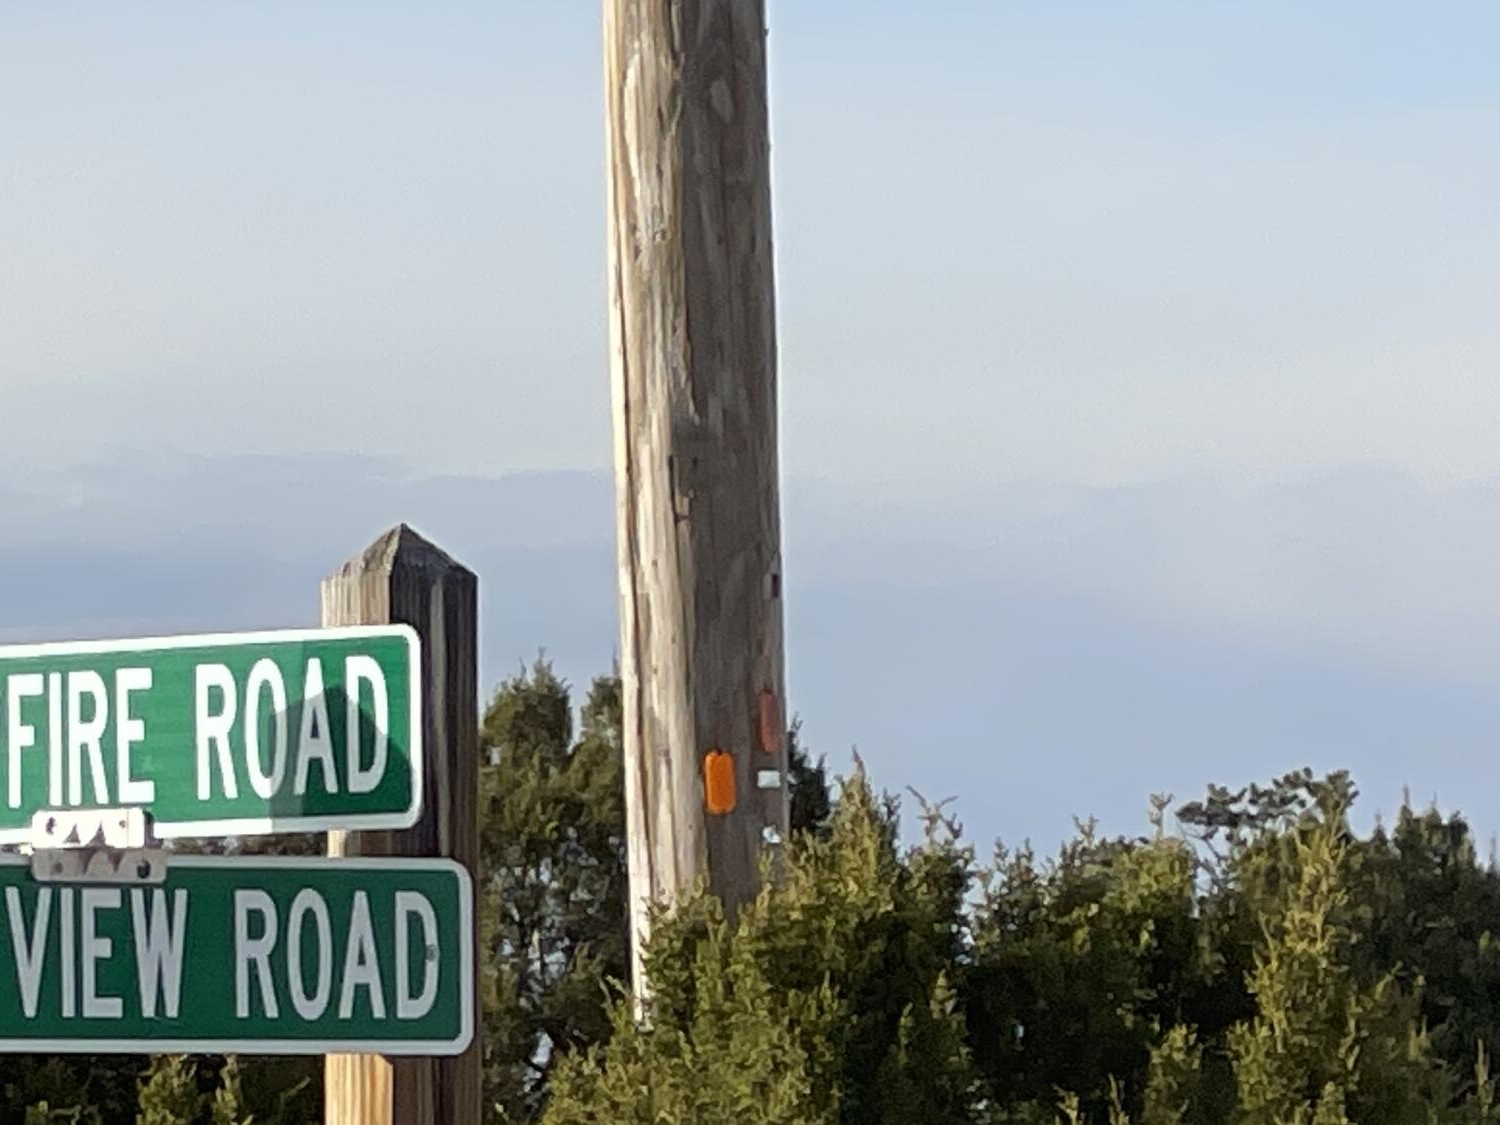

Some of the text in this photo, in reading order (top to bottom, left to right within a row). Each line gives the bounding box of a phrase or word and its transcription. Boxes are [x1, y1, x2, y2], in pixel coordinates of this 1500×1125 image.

[196, 656, 389, 800] ROAD
[5, 887, 187, 1018] VIEW
[236, 889, 439, 1020] ROAD
